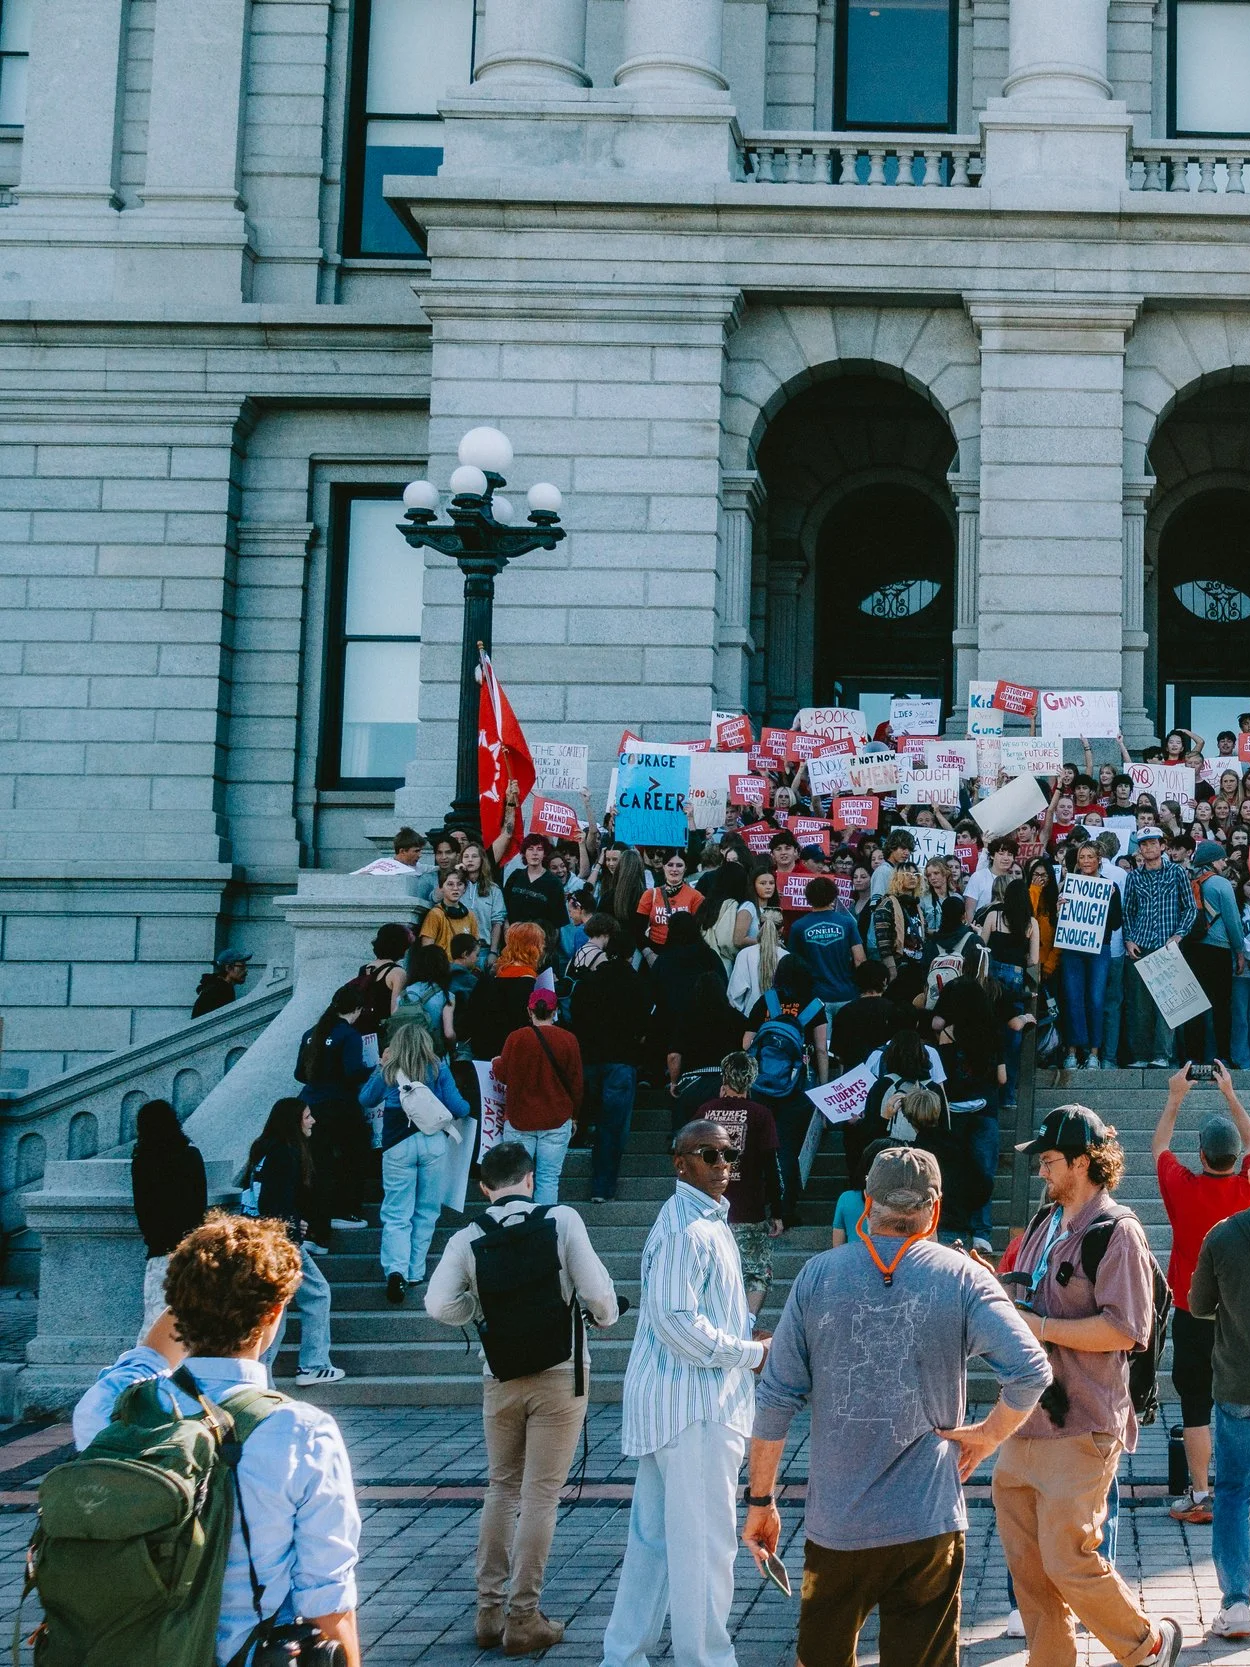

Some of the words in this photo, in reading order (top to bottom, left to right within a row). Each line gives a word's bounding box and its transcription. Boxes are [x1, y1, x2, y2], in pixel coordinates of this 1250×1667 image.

[1000, 693, 1023, 703] DEMAND
[1006, 686, 1033, 698] STUDENTS
[970, 694, 994, 708] Kid
[1005, 702, 1026, 712] ACTION
[814, 710, 857, 724] BOOKS
[722, 720, 745, 732] STUDENTS
[971, 722, 1002, 735] Guns
[721, 730, 739, 740] DEMAND
[728, 736, 745, 747] ACTION
[820, 742, 849, 755] STUDENTS
[1031, 739, 1057, 749] SCHOOL
[532, 745, 555, 757] THE
[1024, 750, 1060, 758] FUTURES
[620, 752, 677, 768] COURAGE
[850, 757, 856, 767] IF
[859, 755, 874, 765] NOT
[876, 753, 896, 763] NOW
[936, 755, 965, 765] STUDENTS
[1027, 762, 1044, 771] END
[563, 768, 569, 776] BE
[811, 759, 847, 776] ENOUG
[551, 776, 581, 790] GRADES
[739, 779, 765, 787] STUDENTS
[1132, 768, 1149, 784] NO
[1158, 770, 1188, 791] MORE
[814, 779, 849, 795] ENOUG
[689, 789, 717, 800] HOOLS
[917, 788, 958, 805] ENOUGH
[1165, 791, 1189, 805] END
[619, 792, 686, 812] CAREER
[841, 801, 872, 810] STUDENTS
[540, 811, 567, 823] DEMAND
[544, 803, 575, 818] STUDENTS
[546, 823, 571, 834] ACTION
[1065, 878, 1112, 900] ENOUGH
[1060, 899, 1107, 926] ENOUGH
[808, 927, 842, 937] O'NEILL
[1056, 926, 1101, 949] ENOUGH.
[1143, 950, 1178, 975] MAKE
[824, 1079, 867, 1106] STUDENTS
[831, 1082, 845, 1092] Text
[705, 1109, 747, 1122] NATURE'S
